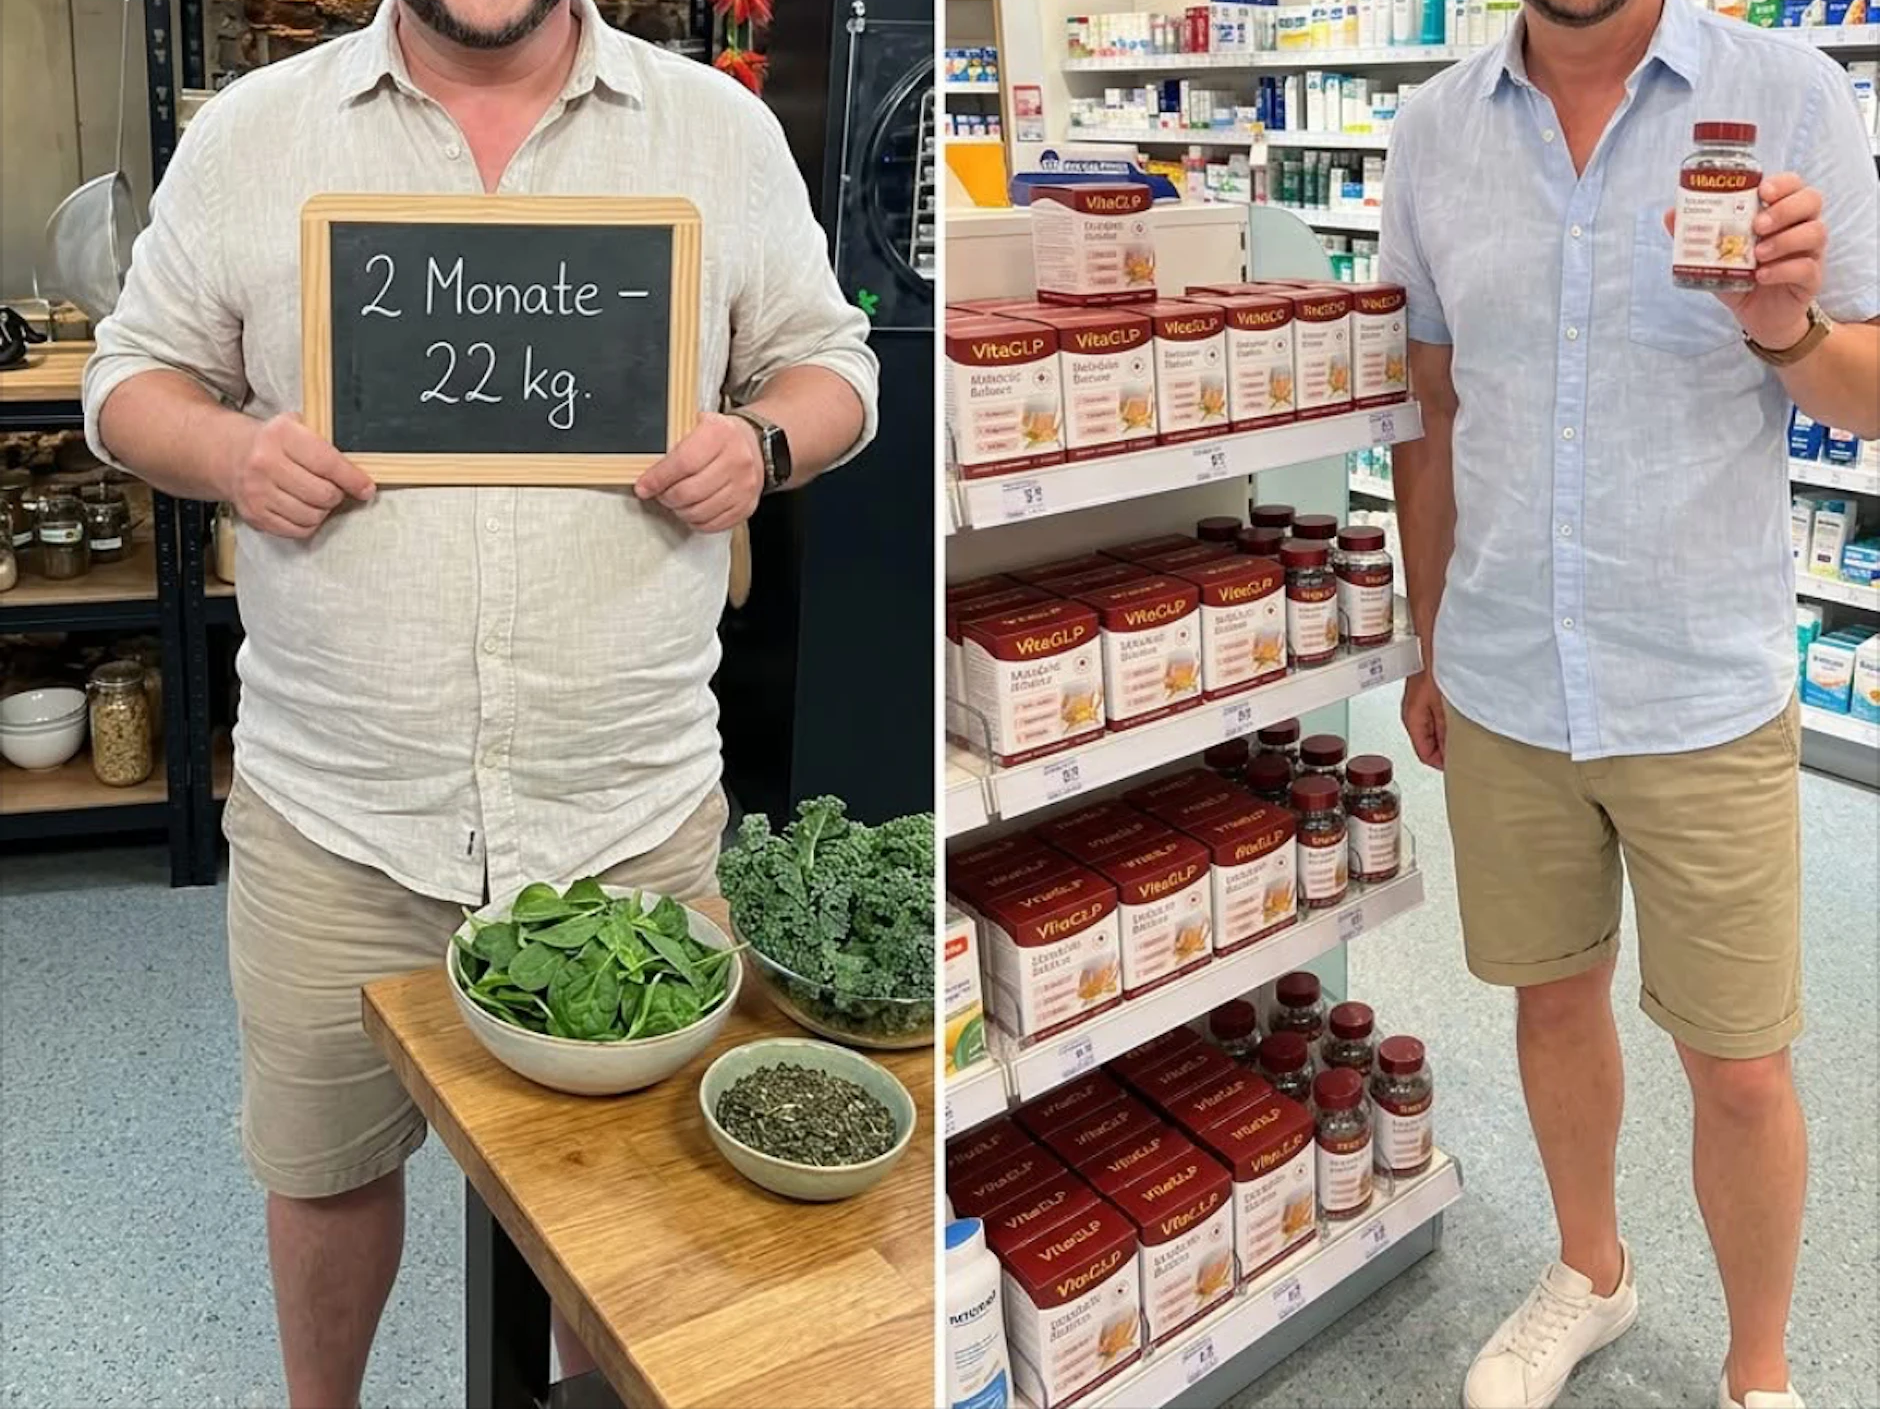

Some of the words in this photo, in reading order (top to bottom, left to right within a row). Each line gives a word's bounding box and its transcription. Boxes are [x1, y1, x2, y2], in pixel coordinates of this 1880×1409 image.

[361, 254, 403, 318] 2
[425, 256, 603, 316] Monate
[972, 339, 1044, 360] VitaGLP
[1075, 328, 1141, 349] VitaGLP
[420, 341, 502, 404] 22
[523, 345, 592, 430] kg.
